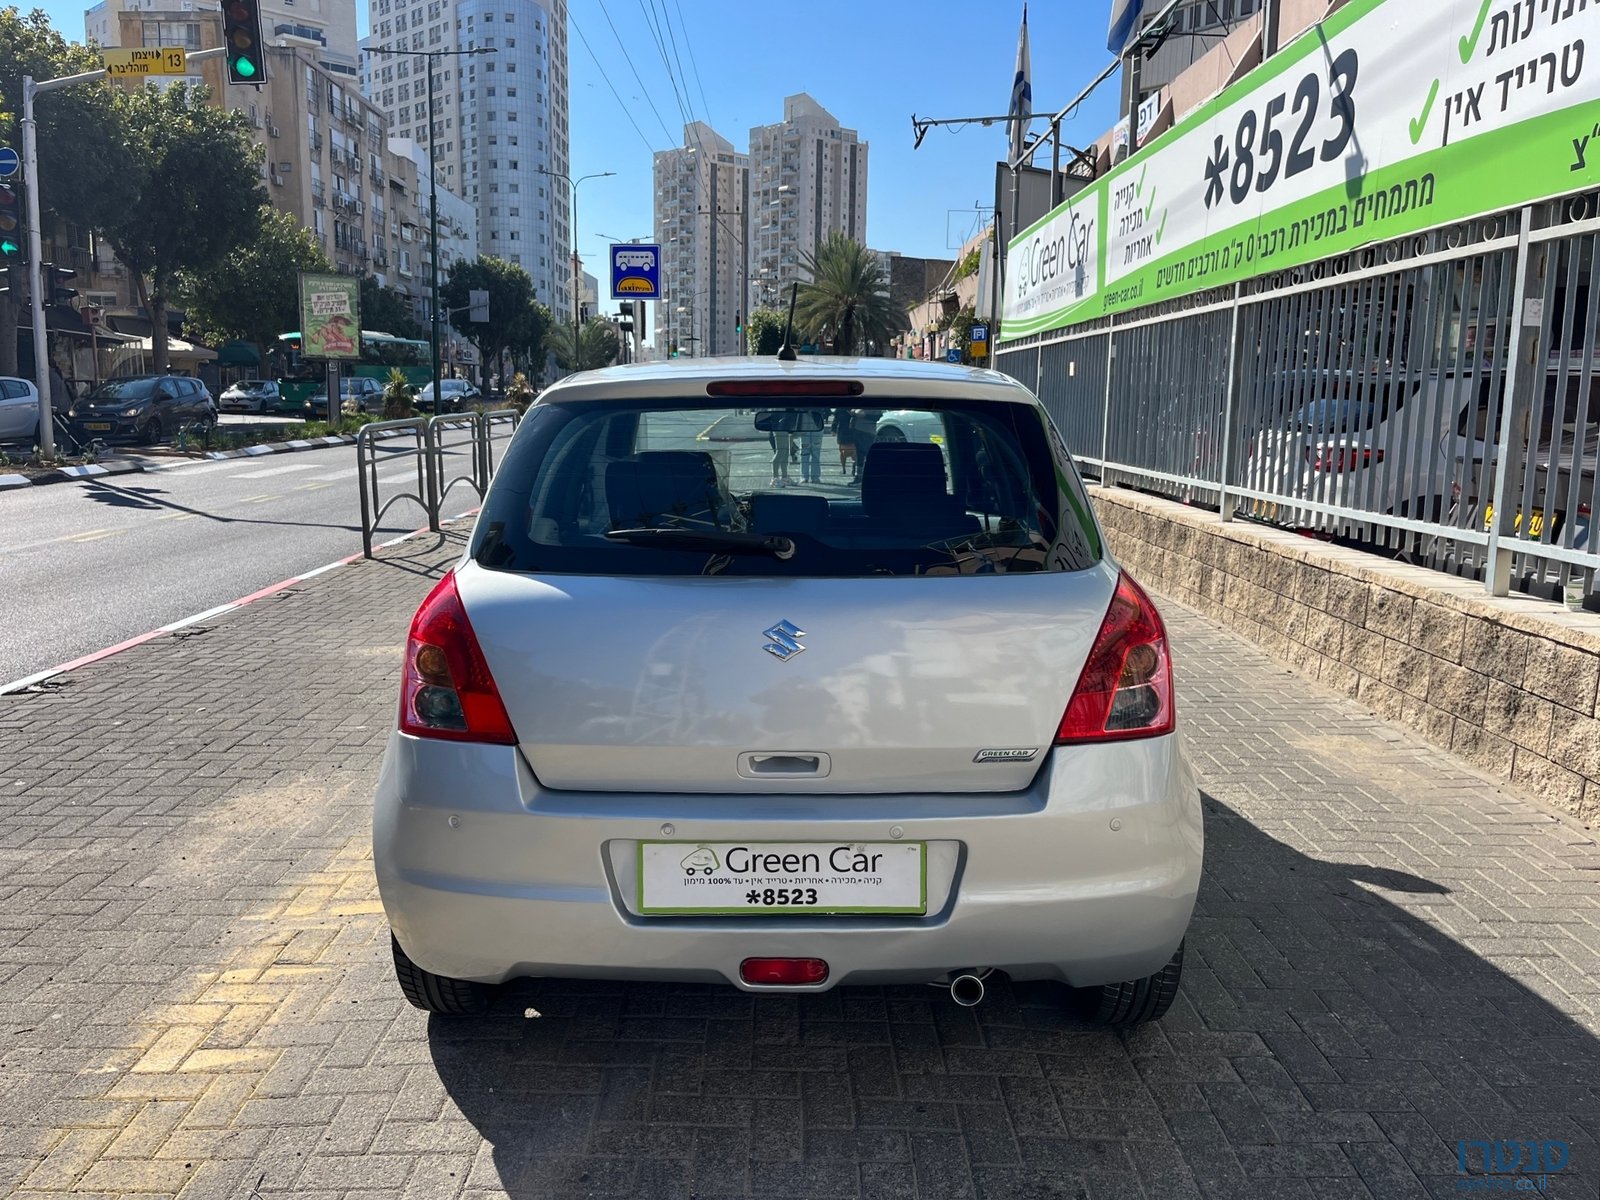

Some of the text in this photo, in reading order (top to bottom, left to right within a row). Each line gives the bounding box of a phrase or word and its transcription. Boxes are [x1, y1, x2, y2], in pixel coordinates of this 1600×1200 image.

[167, 53, 182, 67] 13
[1441, 38, 1585, 147] טרייד אין
[1114, 181, 1135, 211] קנייה
[1353, 172, 1435, 228] מתמחים
[1119, 207, 1143, 238] מכירה
[1288, 204, 1348, 250] במכירת
[1030, 211, 1094, 287] Green Car
[1124, 234, 1153, 266] אחריות
[1187, 249, 1220, 280] ורכבים
[1156, 261, 1186, 289] חדשים
[725, 846, 883, 874] Green Car
[683, 877, 882, 887] קניה מכירה אחריות טרייד אין עד 100% מימון
